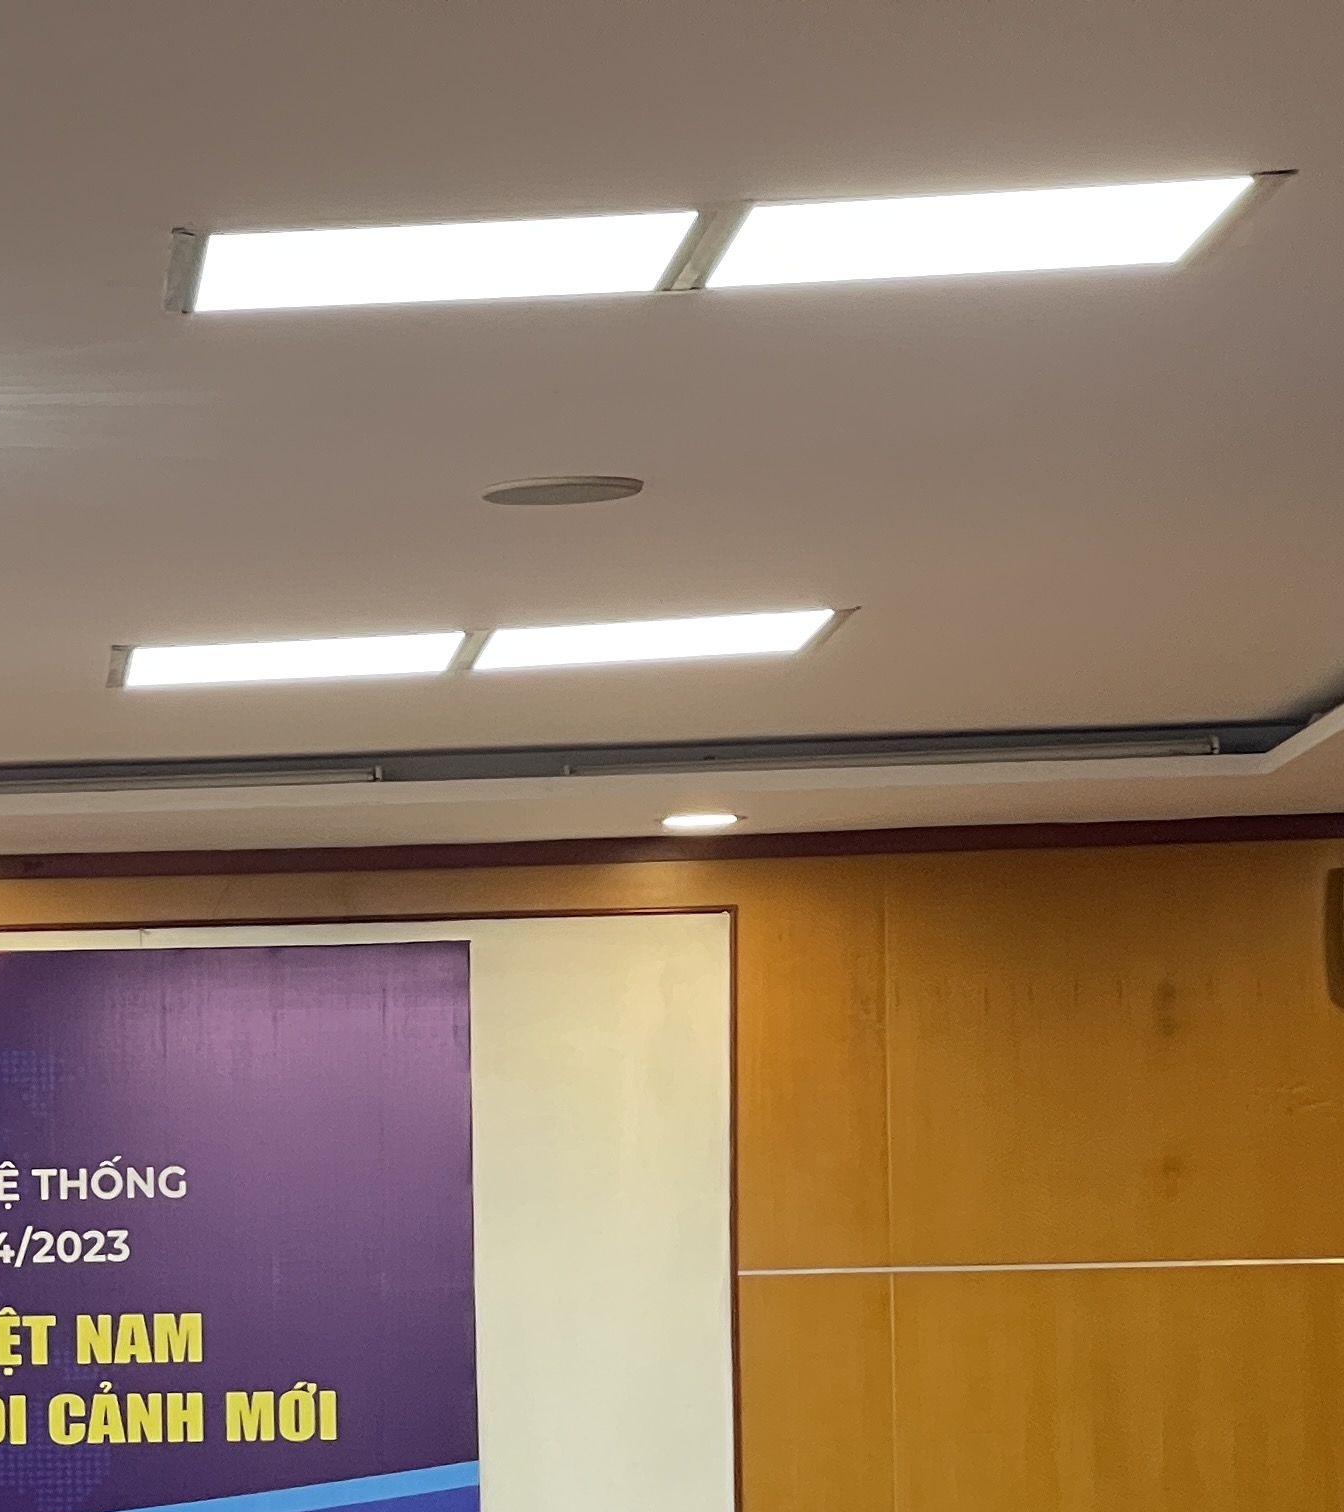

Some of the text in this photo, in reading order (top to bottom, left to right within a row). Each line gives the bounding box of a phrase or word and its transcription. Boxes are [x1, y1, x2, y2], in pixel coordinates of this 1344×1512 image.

[31, 1155, 187, 1201] THỐNG
[76, 1312, 203, 1365] NAM
[48, 1380, 204, 1446] CẢNH
[225, 1381, 338, 1442] MỚI
